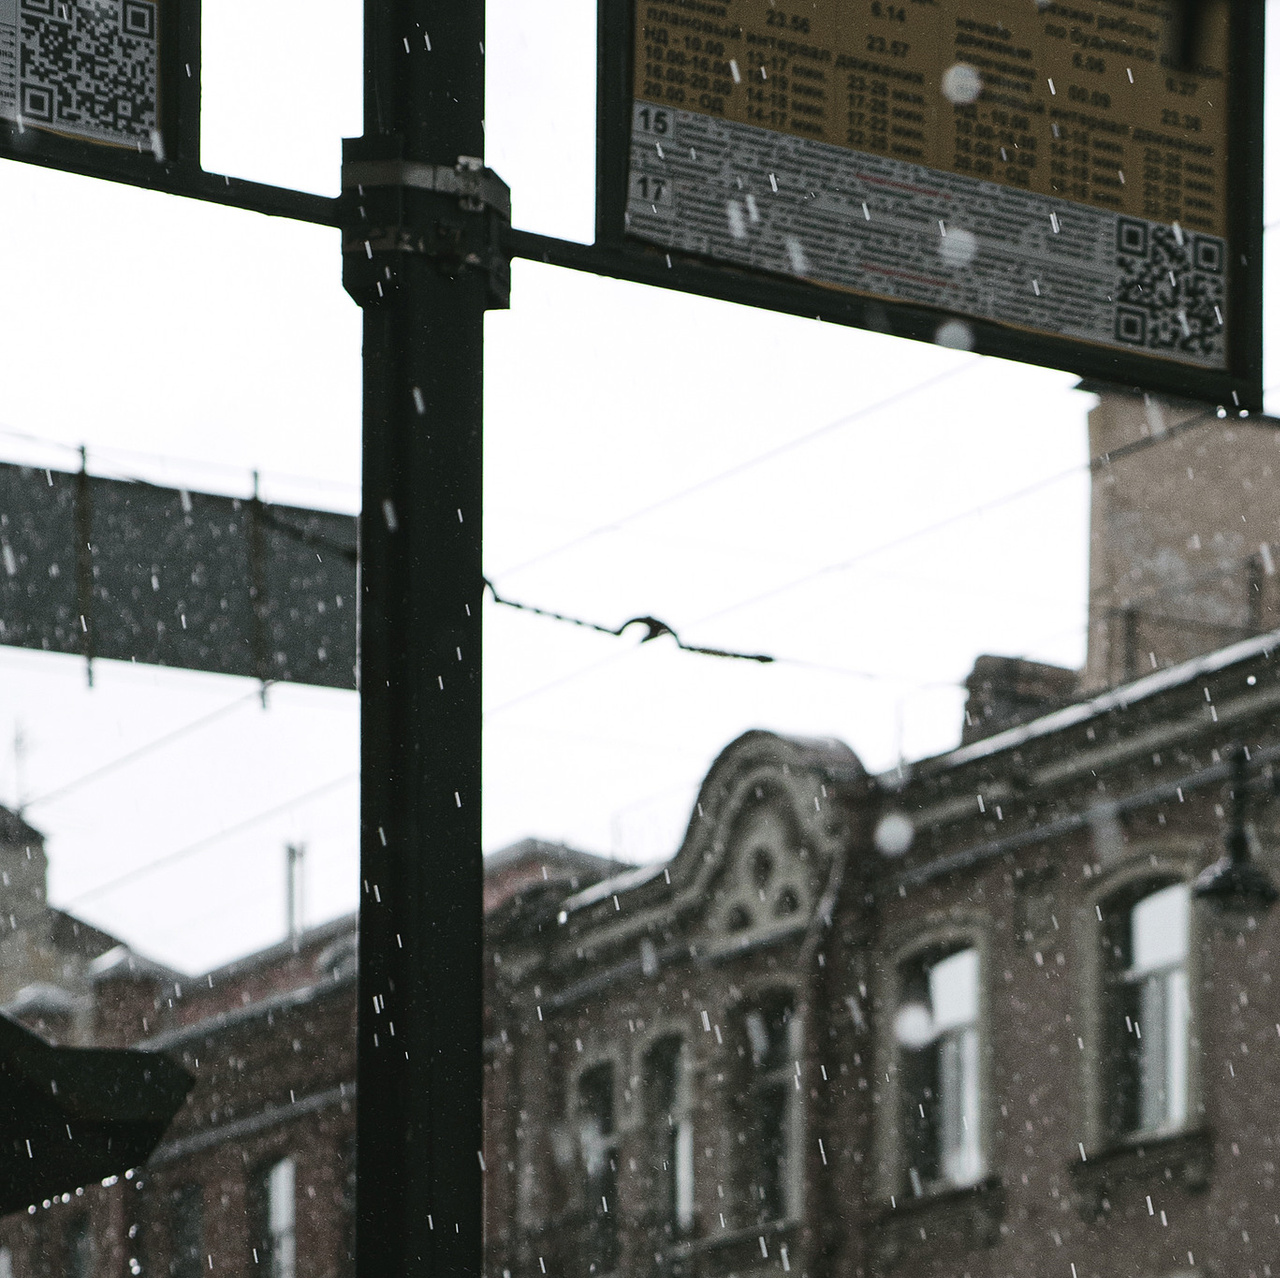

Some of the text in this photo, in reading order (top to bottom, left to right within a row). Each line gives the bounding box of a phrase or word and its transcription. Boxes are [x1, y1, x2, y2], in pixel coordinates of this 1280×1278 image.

[644, 25, 668, 46] НД
[792, 65, 827, 81] мин.
[892, 89, 928, 106] мин.
[647, 7, 924, 84] плановый интервал движения
[954, 32, 1033, 60] движения
[639, 106, 669, 135] 15
[792, 83, 827, 99] мин.
[892, 107, 928, 124] мин.
[792, 101, 827, 118] мин.
[892, 125, 928, 142] мин.
[791, 119, 826, 135] мин.
[891, 143, 927, 159] мин.
[1049, 105, 1130, 135] интервал
[1133, 127, 1215, 158] движения
[637, 174, 666, 202] 17
